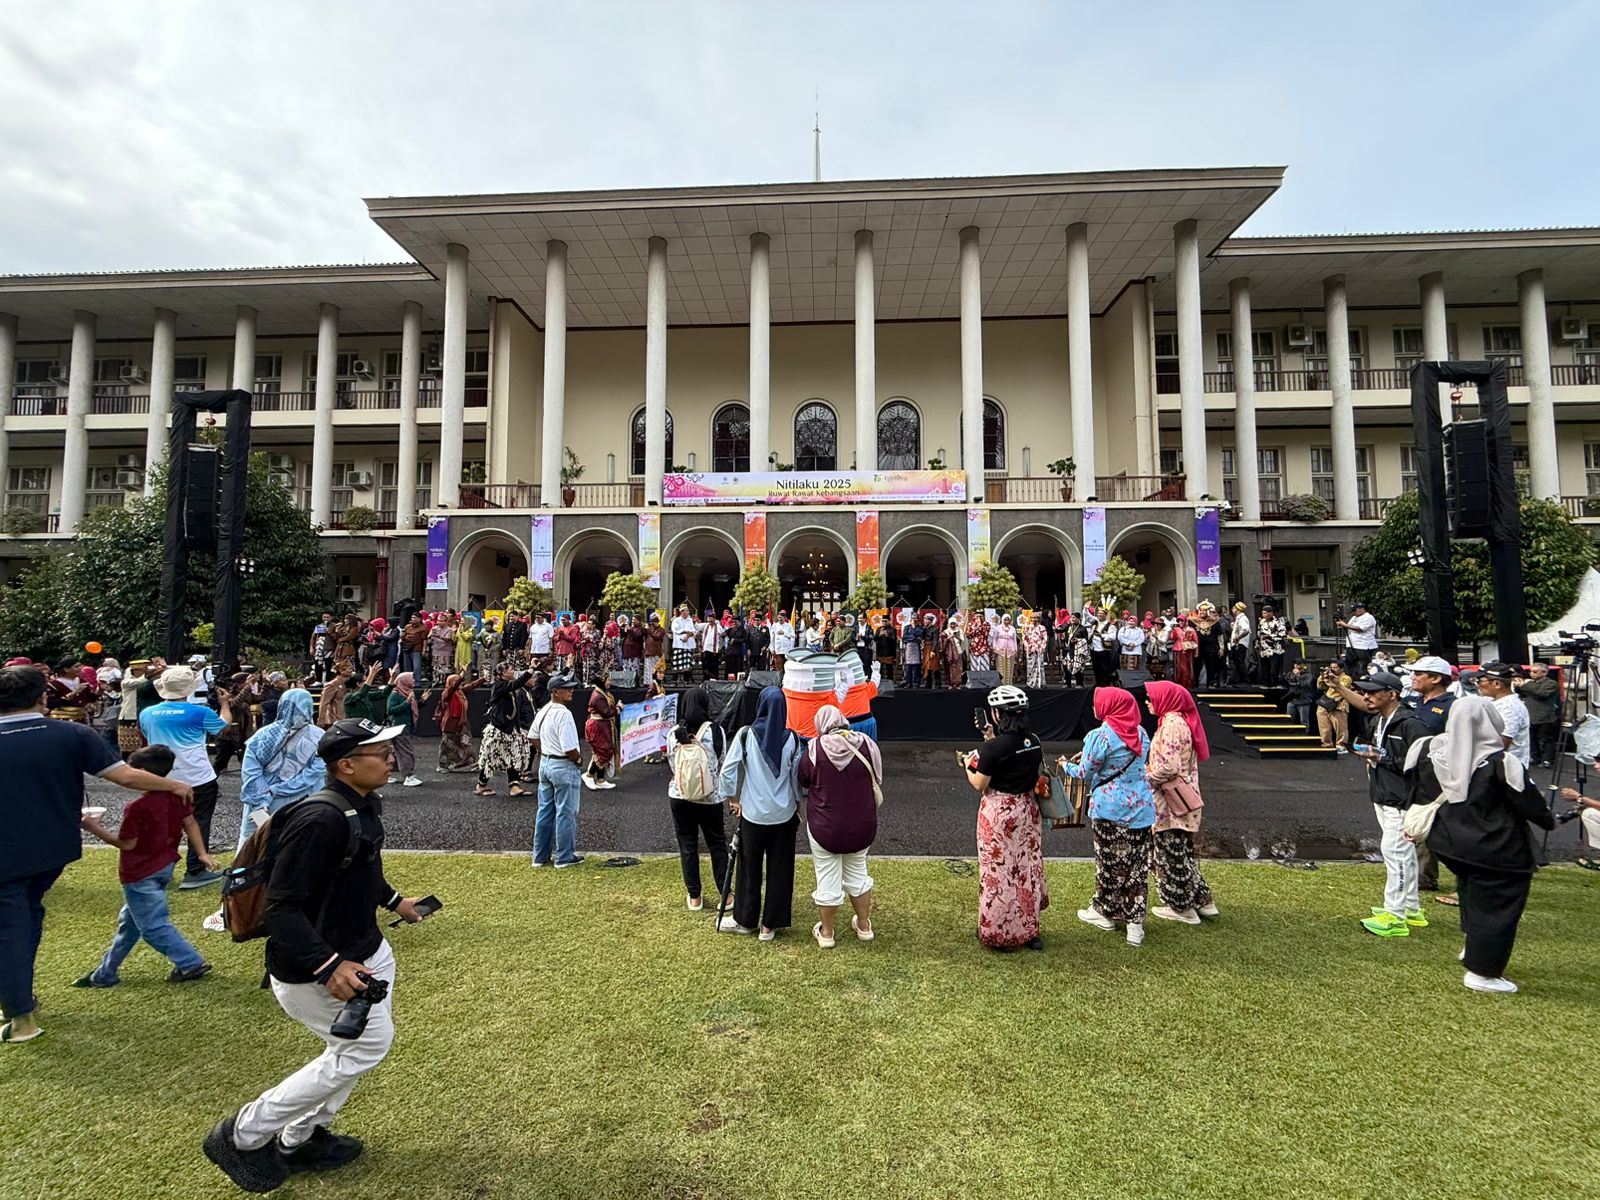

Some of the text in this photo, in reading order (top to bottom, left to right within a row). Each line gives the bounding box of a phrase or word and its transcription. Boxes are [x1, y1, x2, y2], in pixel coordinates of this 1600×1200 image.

[776, 478, 851, 489] Nitilaku 2025
[815, 489, 860, 498] Kebangsaan
